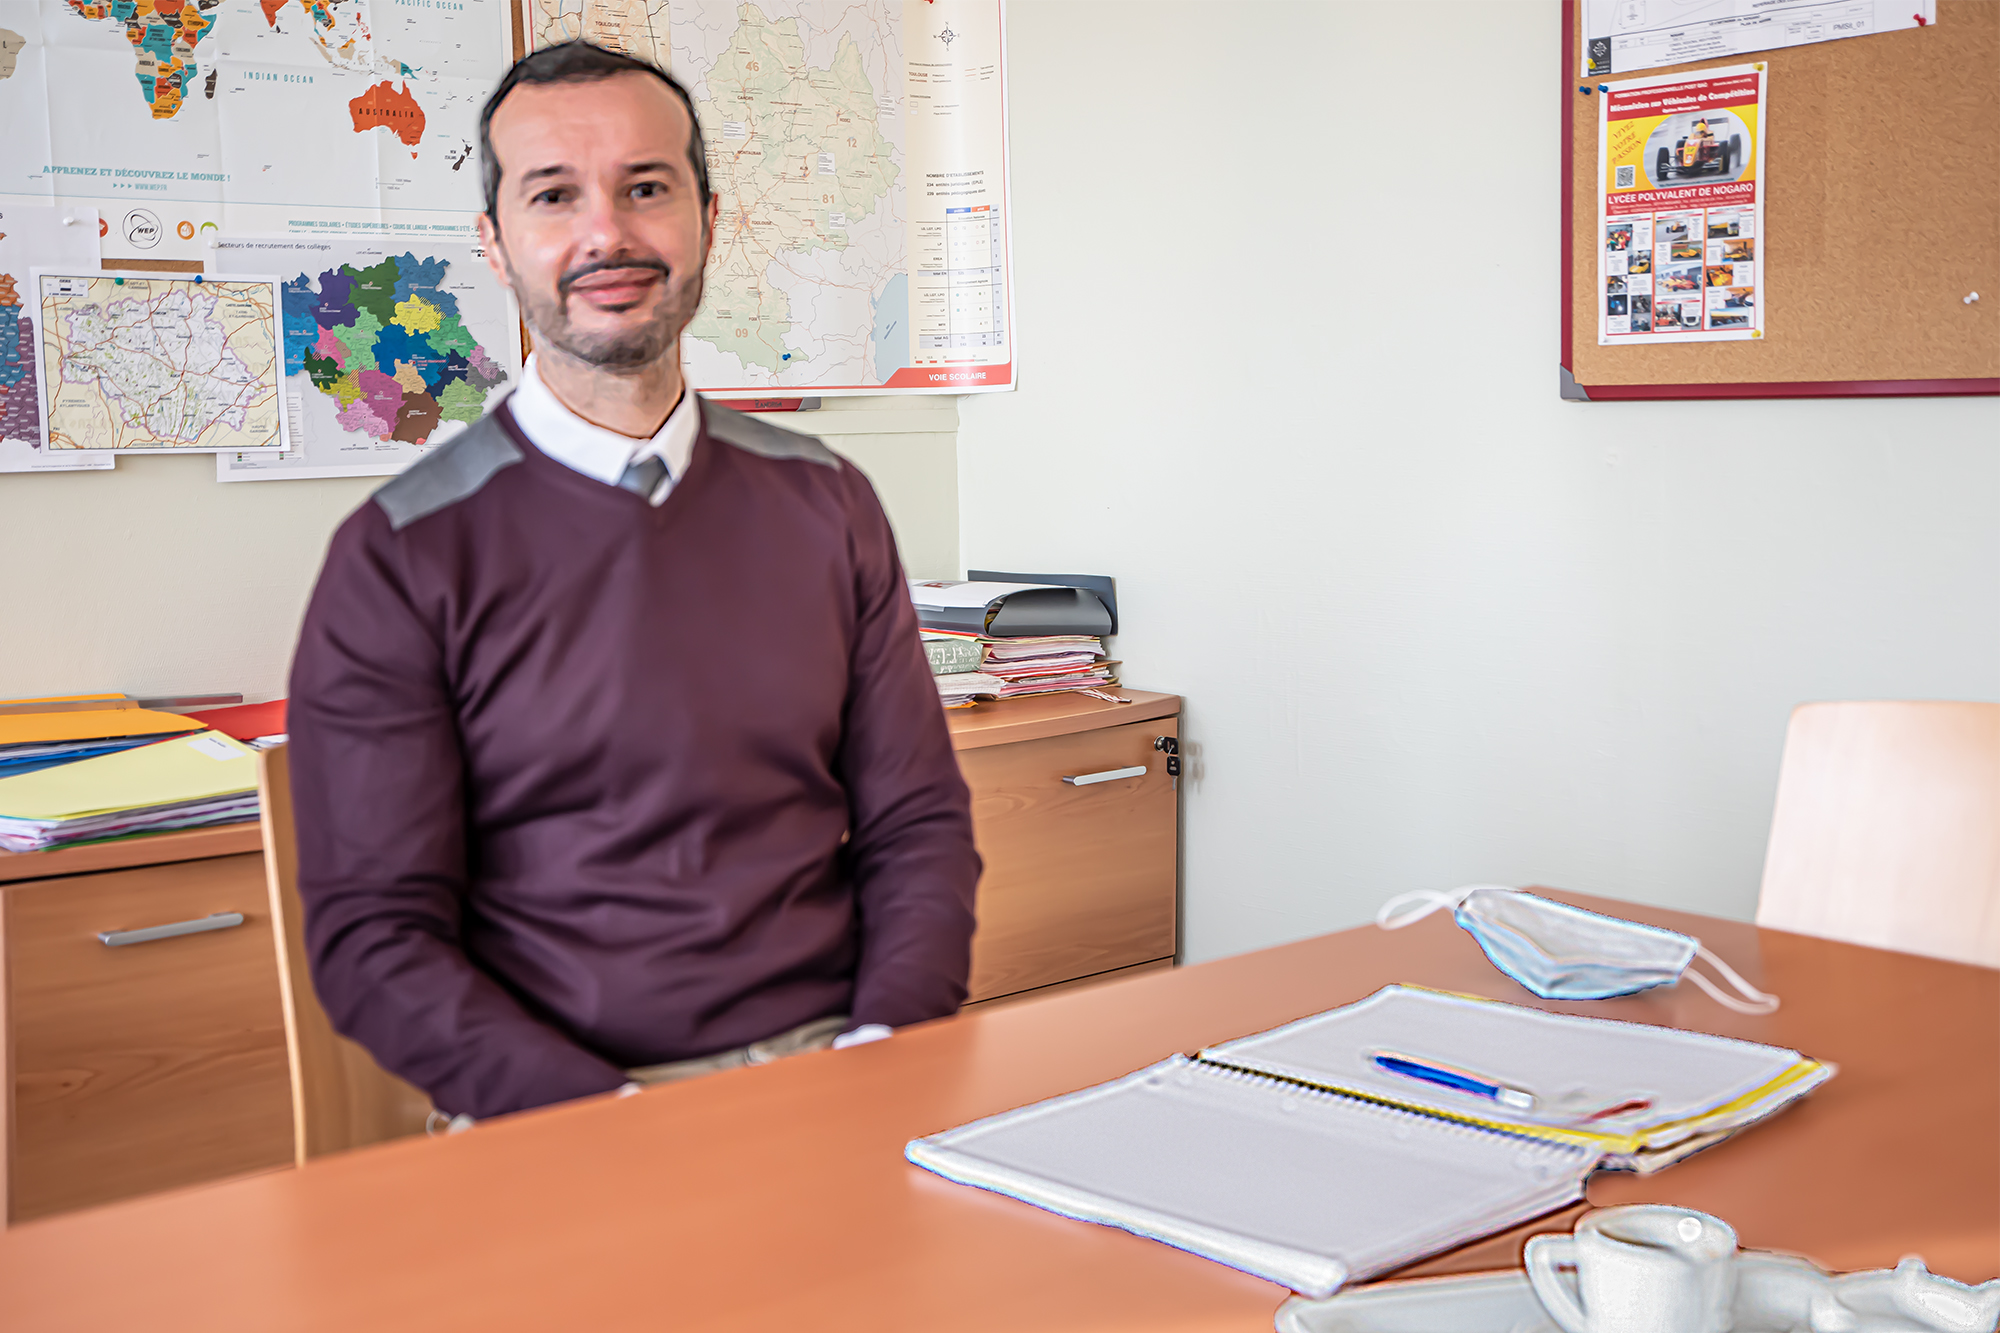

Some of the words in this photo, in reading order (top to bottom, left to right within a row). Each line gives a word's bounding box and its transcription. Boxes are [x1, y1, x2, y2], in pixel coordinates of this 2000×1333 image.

[436, 1, 464, 11] OCEAN
[745, 62, 760, 72] 46
[244, 71, 278, 82] INDIAN
[284, 74, 314, 84] OCEAN
[359, 108, 414, 118] AUSTRALIA
[846, 138, 857, 148] 12
[706, 159, 720, 168] 82
[42, 165, 98, 176] APPRENEZ
[100, 168, 112, 177] ET
[115, 168, 174, 180] DÉCOUVREZ
[191, 173, 225, 182] MONDE
[822, 194, 835, 204] 81
[1608, 194, 1636, 204] LYCÉE
[1638, 188, 1696, 202] POLYVALENT
[1698, 187, 1711, 196] DE
[1713, 184, 1753, 195] NOGARO
[710, 254, 722, 264] 31
[735, 328, 748, 338] 09
[949, 372, 987, 380] SCOLAIRE
